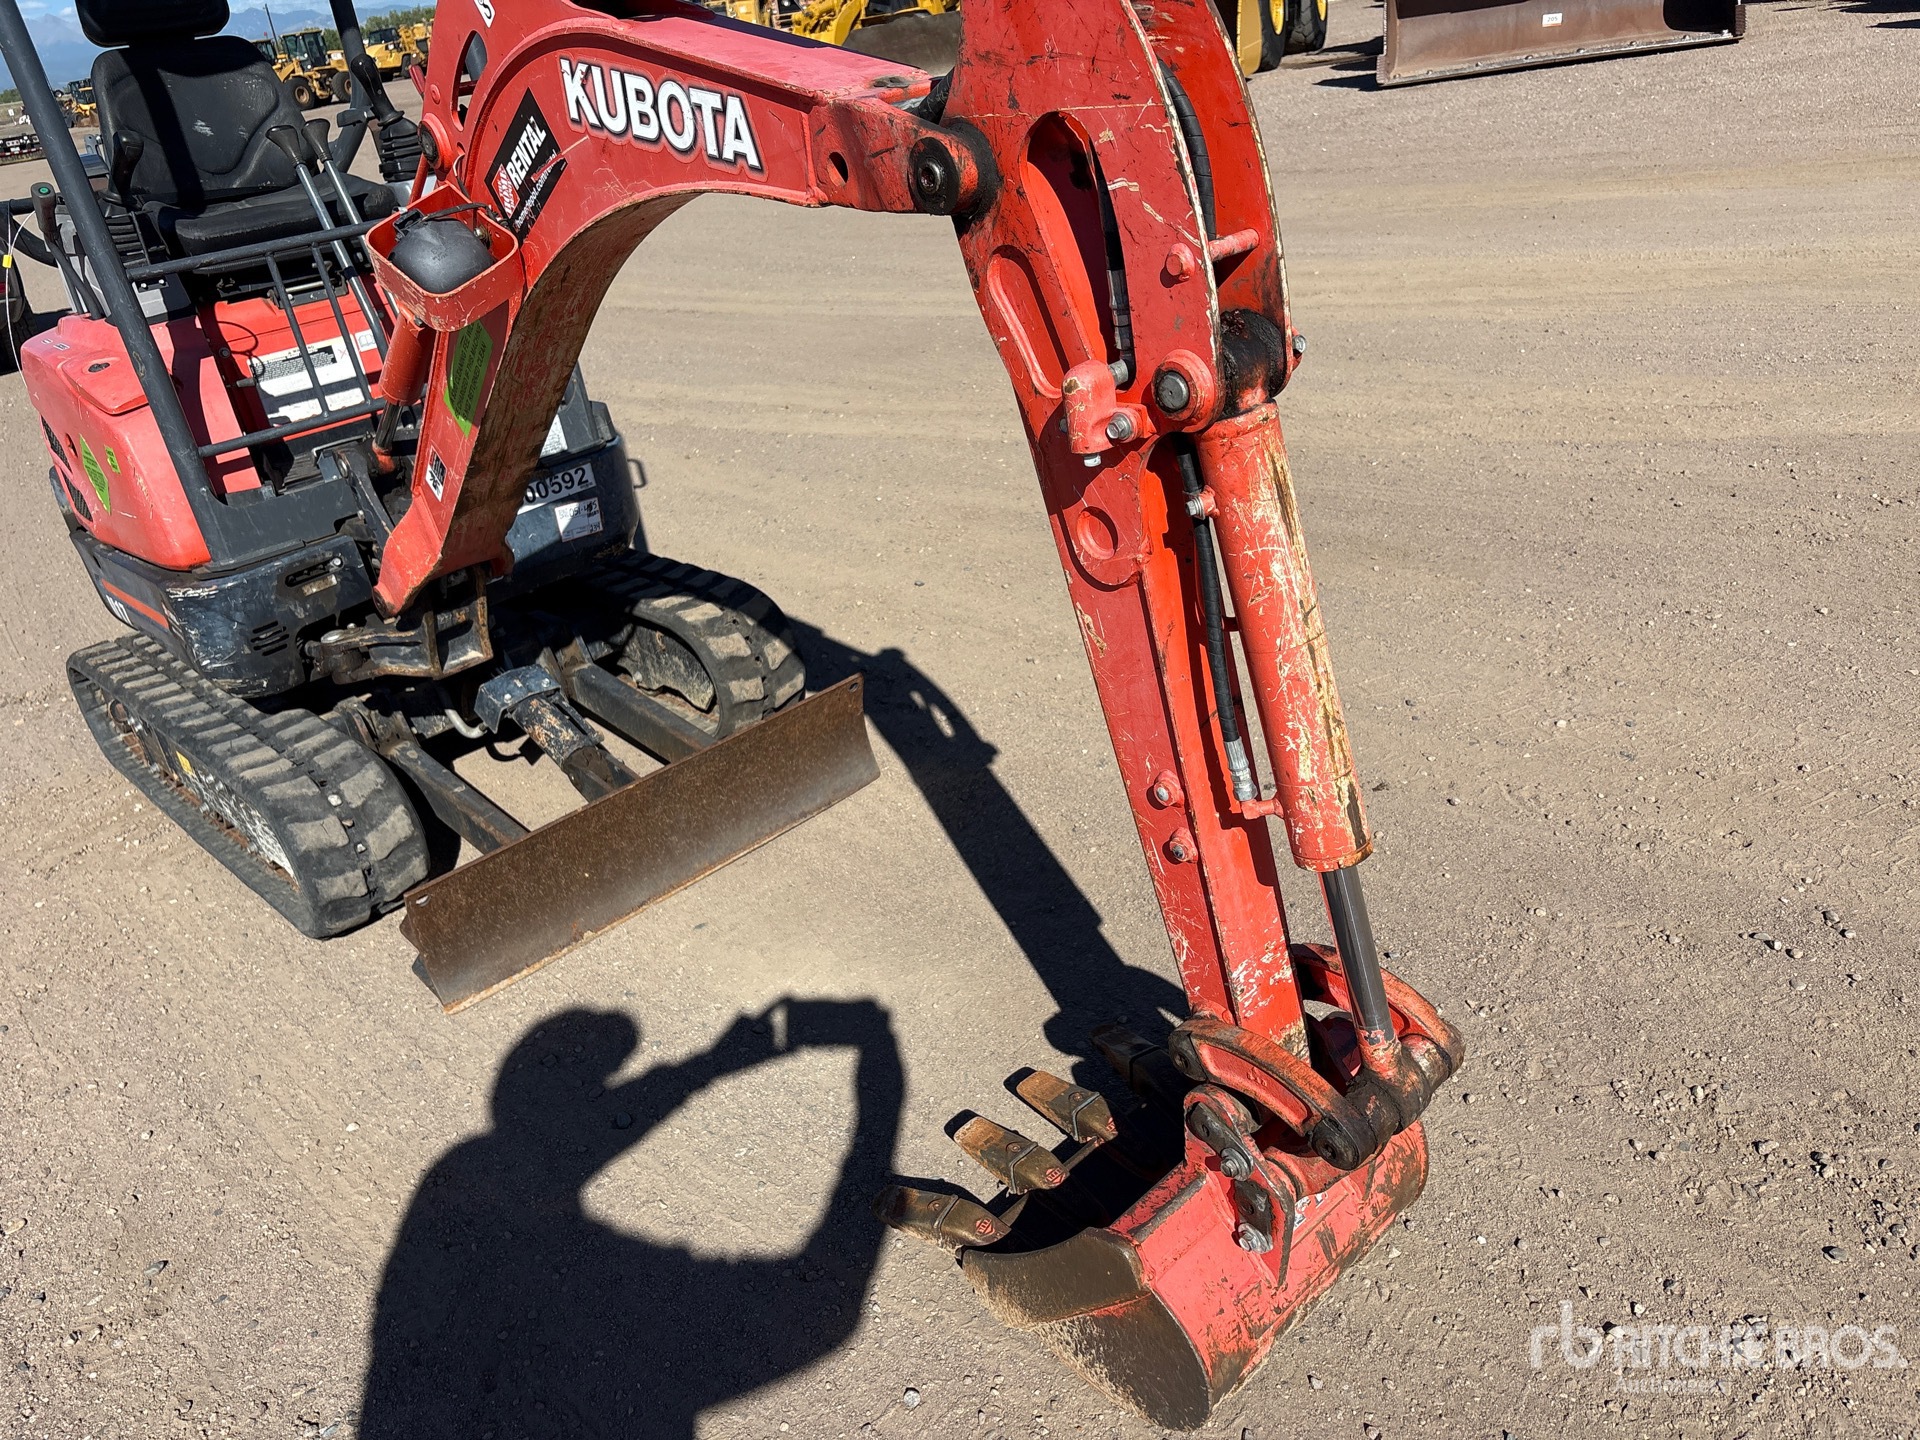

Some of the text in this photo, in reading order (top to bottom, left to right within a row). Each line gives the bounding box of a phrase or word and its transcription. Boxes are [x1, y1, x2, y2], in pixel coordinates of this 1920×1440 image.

[560, 58, 762, 170] KUBOTA
[506, 115, 547, 191] RENTAL
[471, 323, 483, 355] MACHINE
[478, 341, 487, 367] CLEAN
